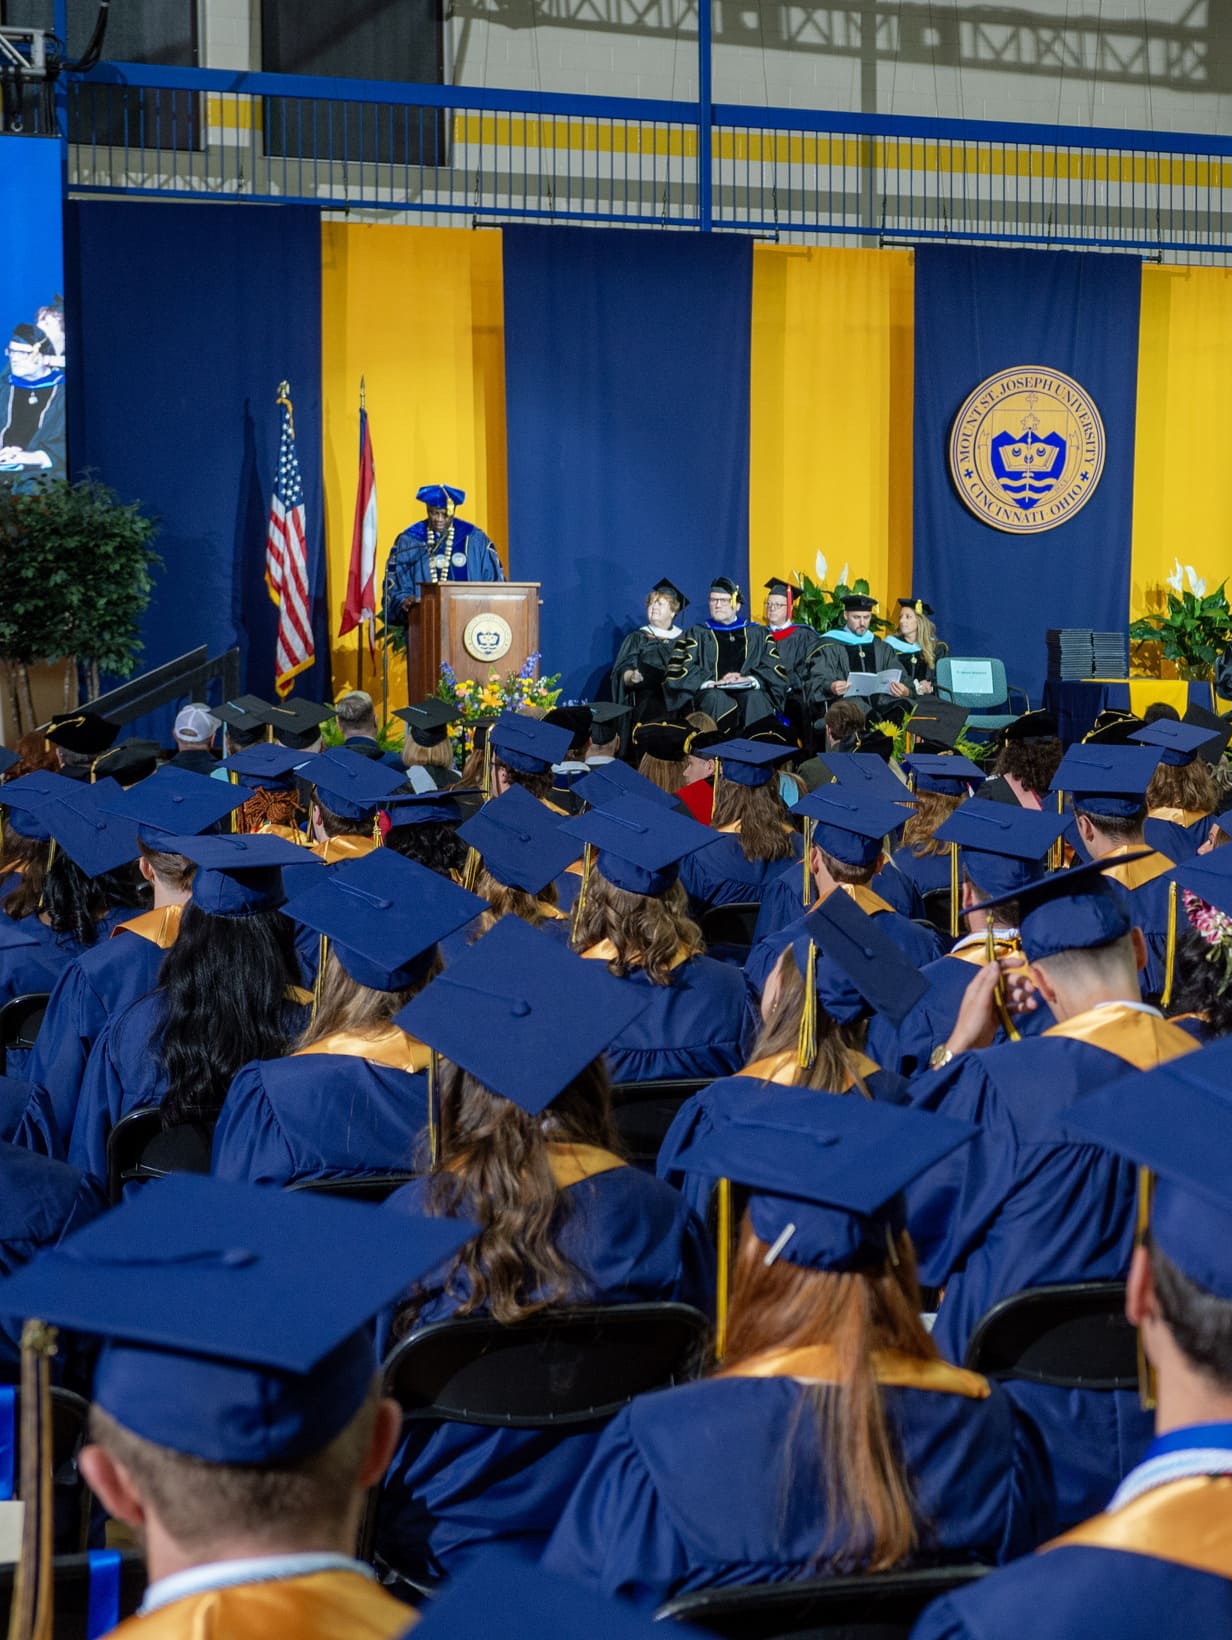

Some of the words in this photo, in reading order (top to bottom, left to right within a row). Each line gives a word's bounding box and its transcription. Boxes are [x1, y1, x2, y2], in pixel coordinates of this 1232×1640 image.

[959, 407, 983, 463] MOUNT
[981, 390, 999, 409] ST.
[1000, 377, 1053, 396] JOSEPH
[1056, 384, 1097, 466] UNIVERSITY
[970, 482, 1046, 524] CINCINNATI
[1050, 484, 1083, 516] OHIO
